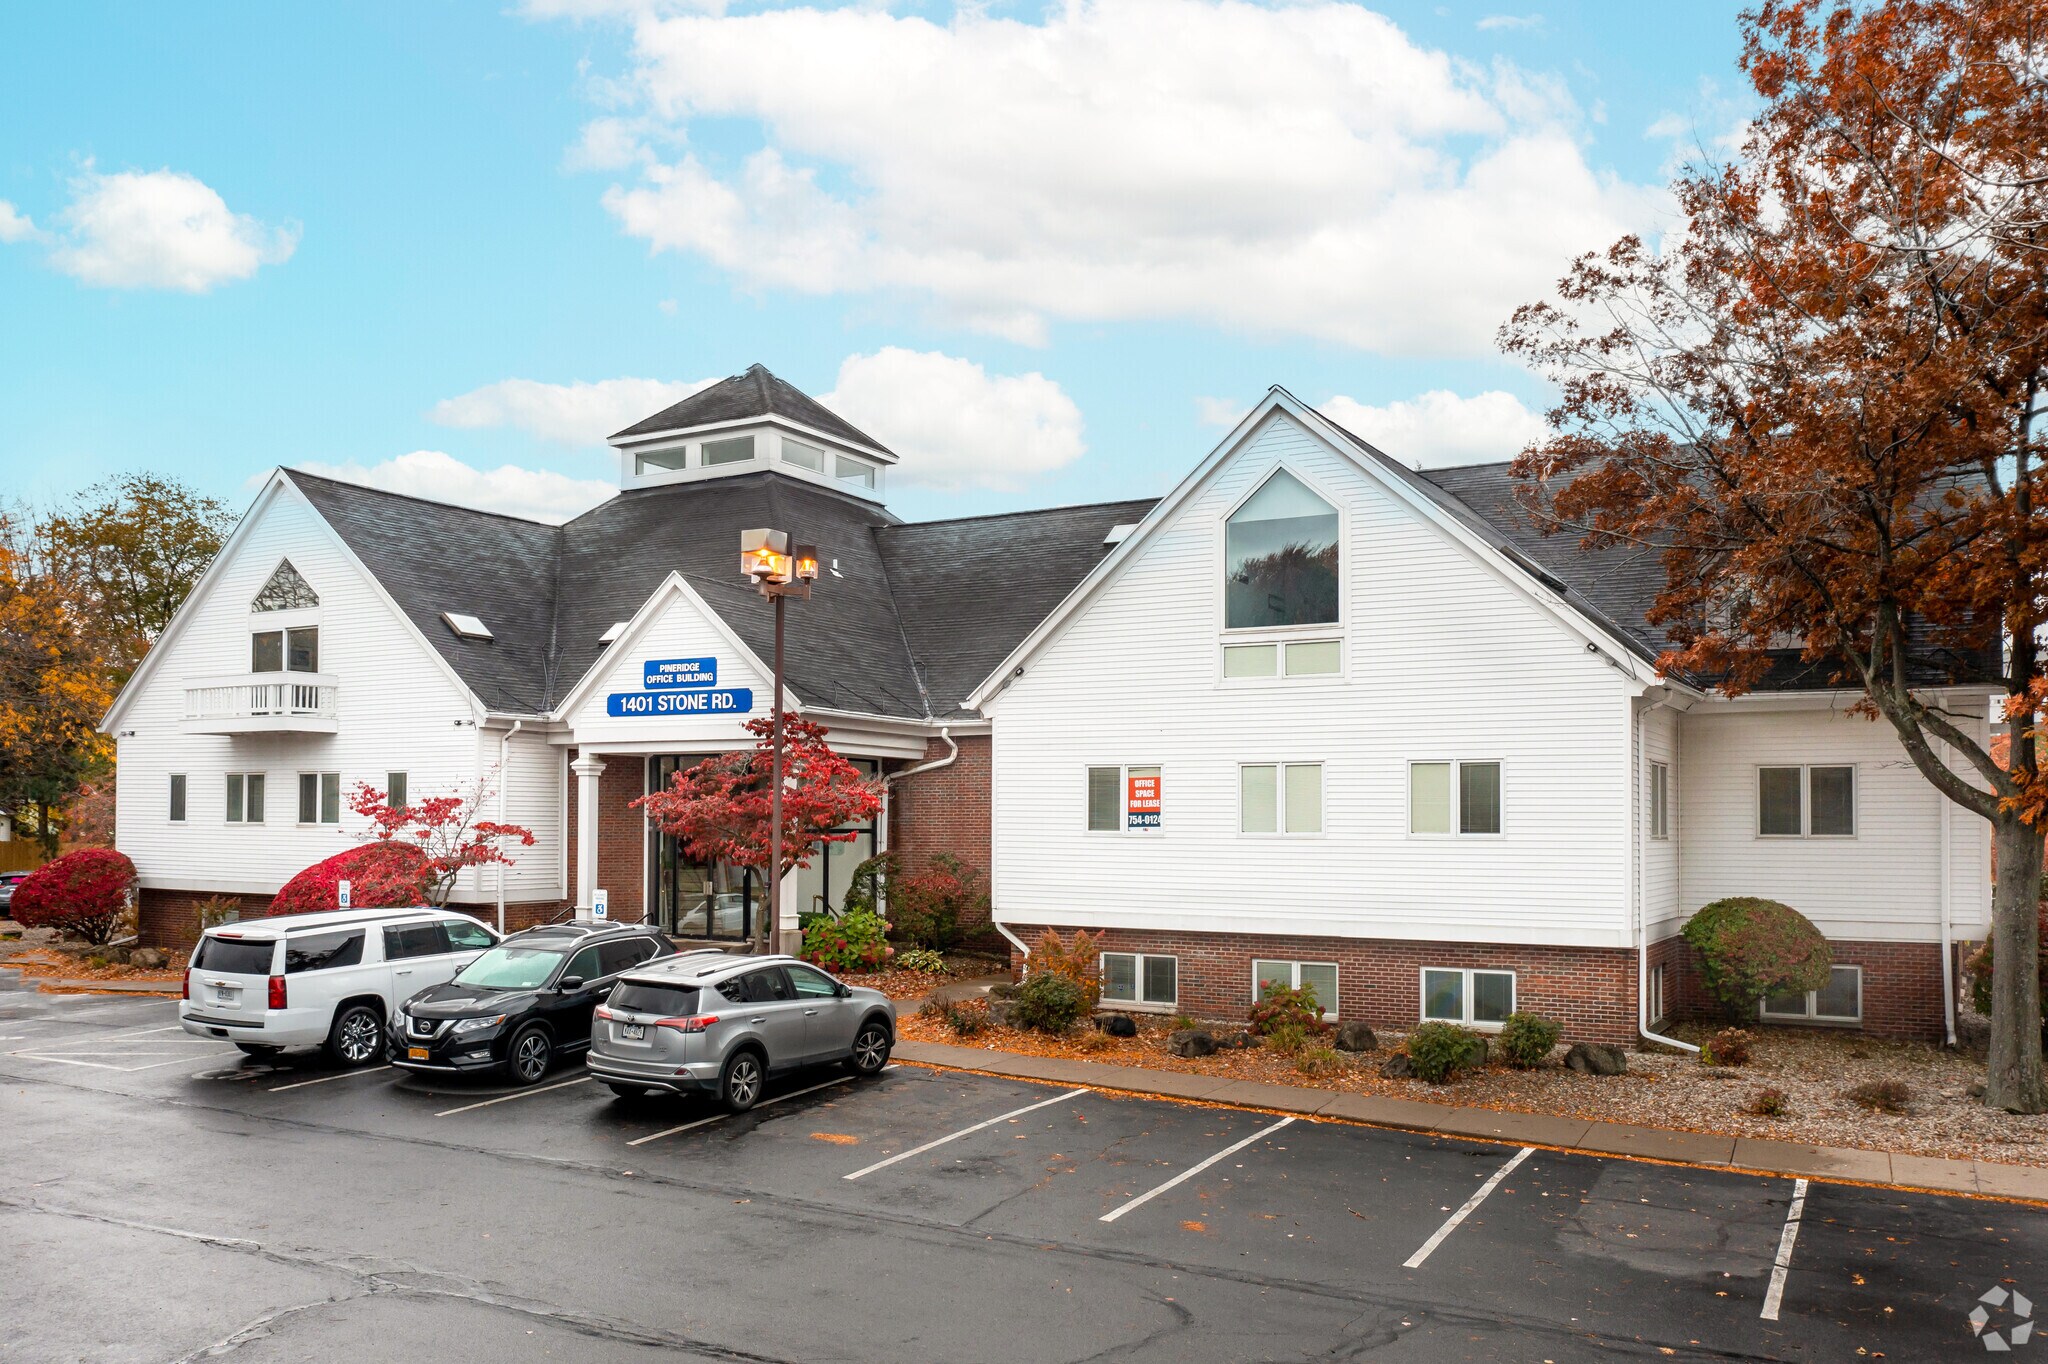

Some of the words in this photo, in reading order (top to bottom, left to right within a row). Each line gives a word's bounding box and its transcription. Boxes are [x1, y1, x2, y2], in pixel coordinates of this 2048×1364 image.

[660, 663, 700, 673] PINERIDGE
[646, 674, 673, 684] OFFICE
[676, 673, 713, 682] BUILDING
[620, 696, 652, 712] 1401
[657, 694, 708, 711] STONE
[711, 693, 737, 709] RD.
[1134, 779, 1155, 788] OFFICE
[1135, 789, 1154, 798] SPACE
[1130, 800, 1142, 808] FOR
[1142, 800, 1161, 808] LEASE
